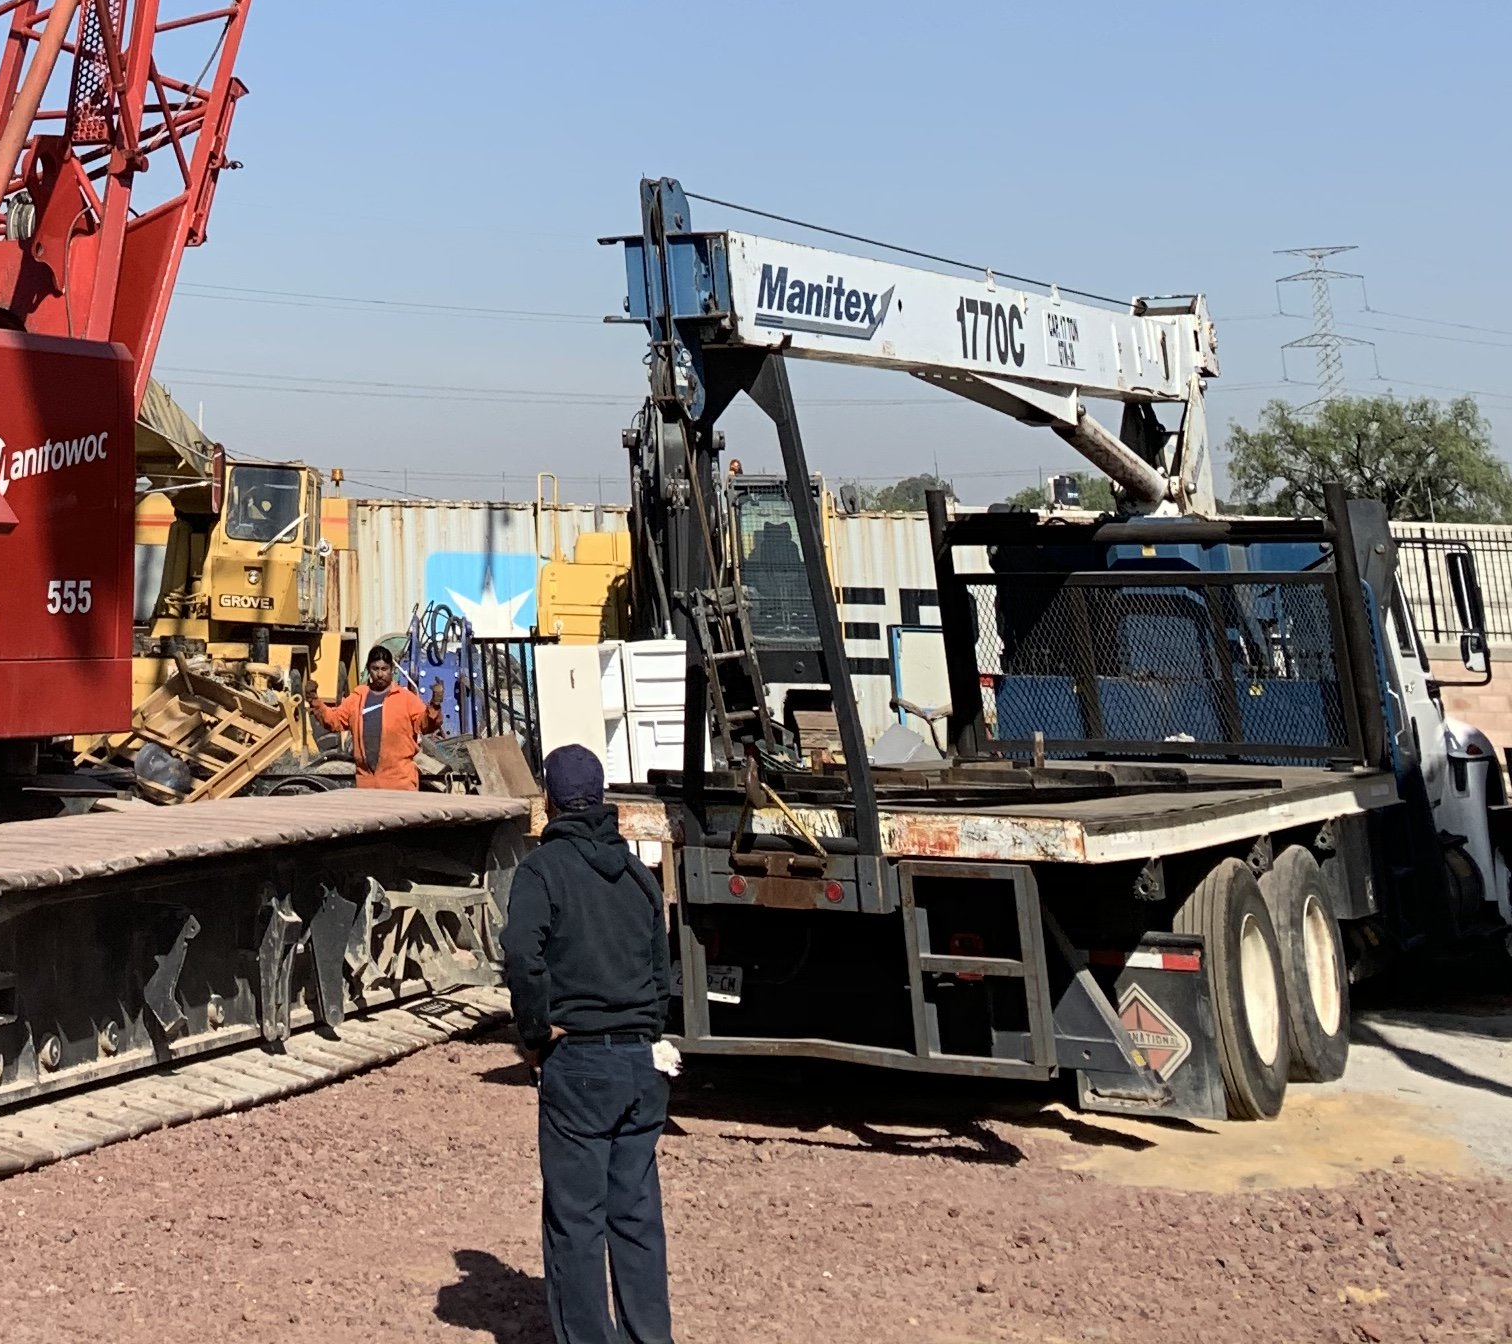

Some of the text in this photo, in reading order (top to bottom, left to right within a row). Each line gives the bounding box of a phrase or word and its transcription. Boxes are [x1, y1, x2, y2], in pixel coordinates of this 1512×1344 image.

[756, 263, 878, 325] Manitex
[956, 296, 1025, 368] 1770C
[46, 580, 92, 614] 555
[219, 594, 270, 610] GROVE
